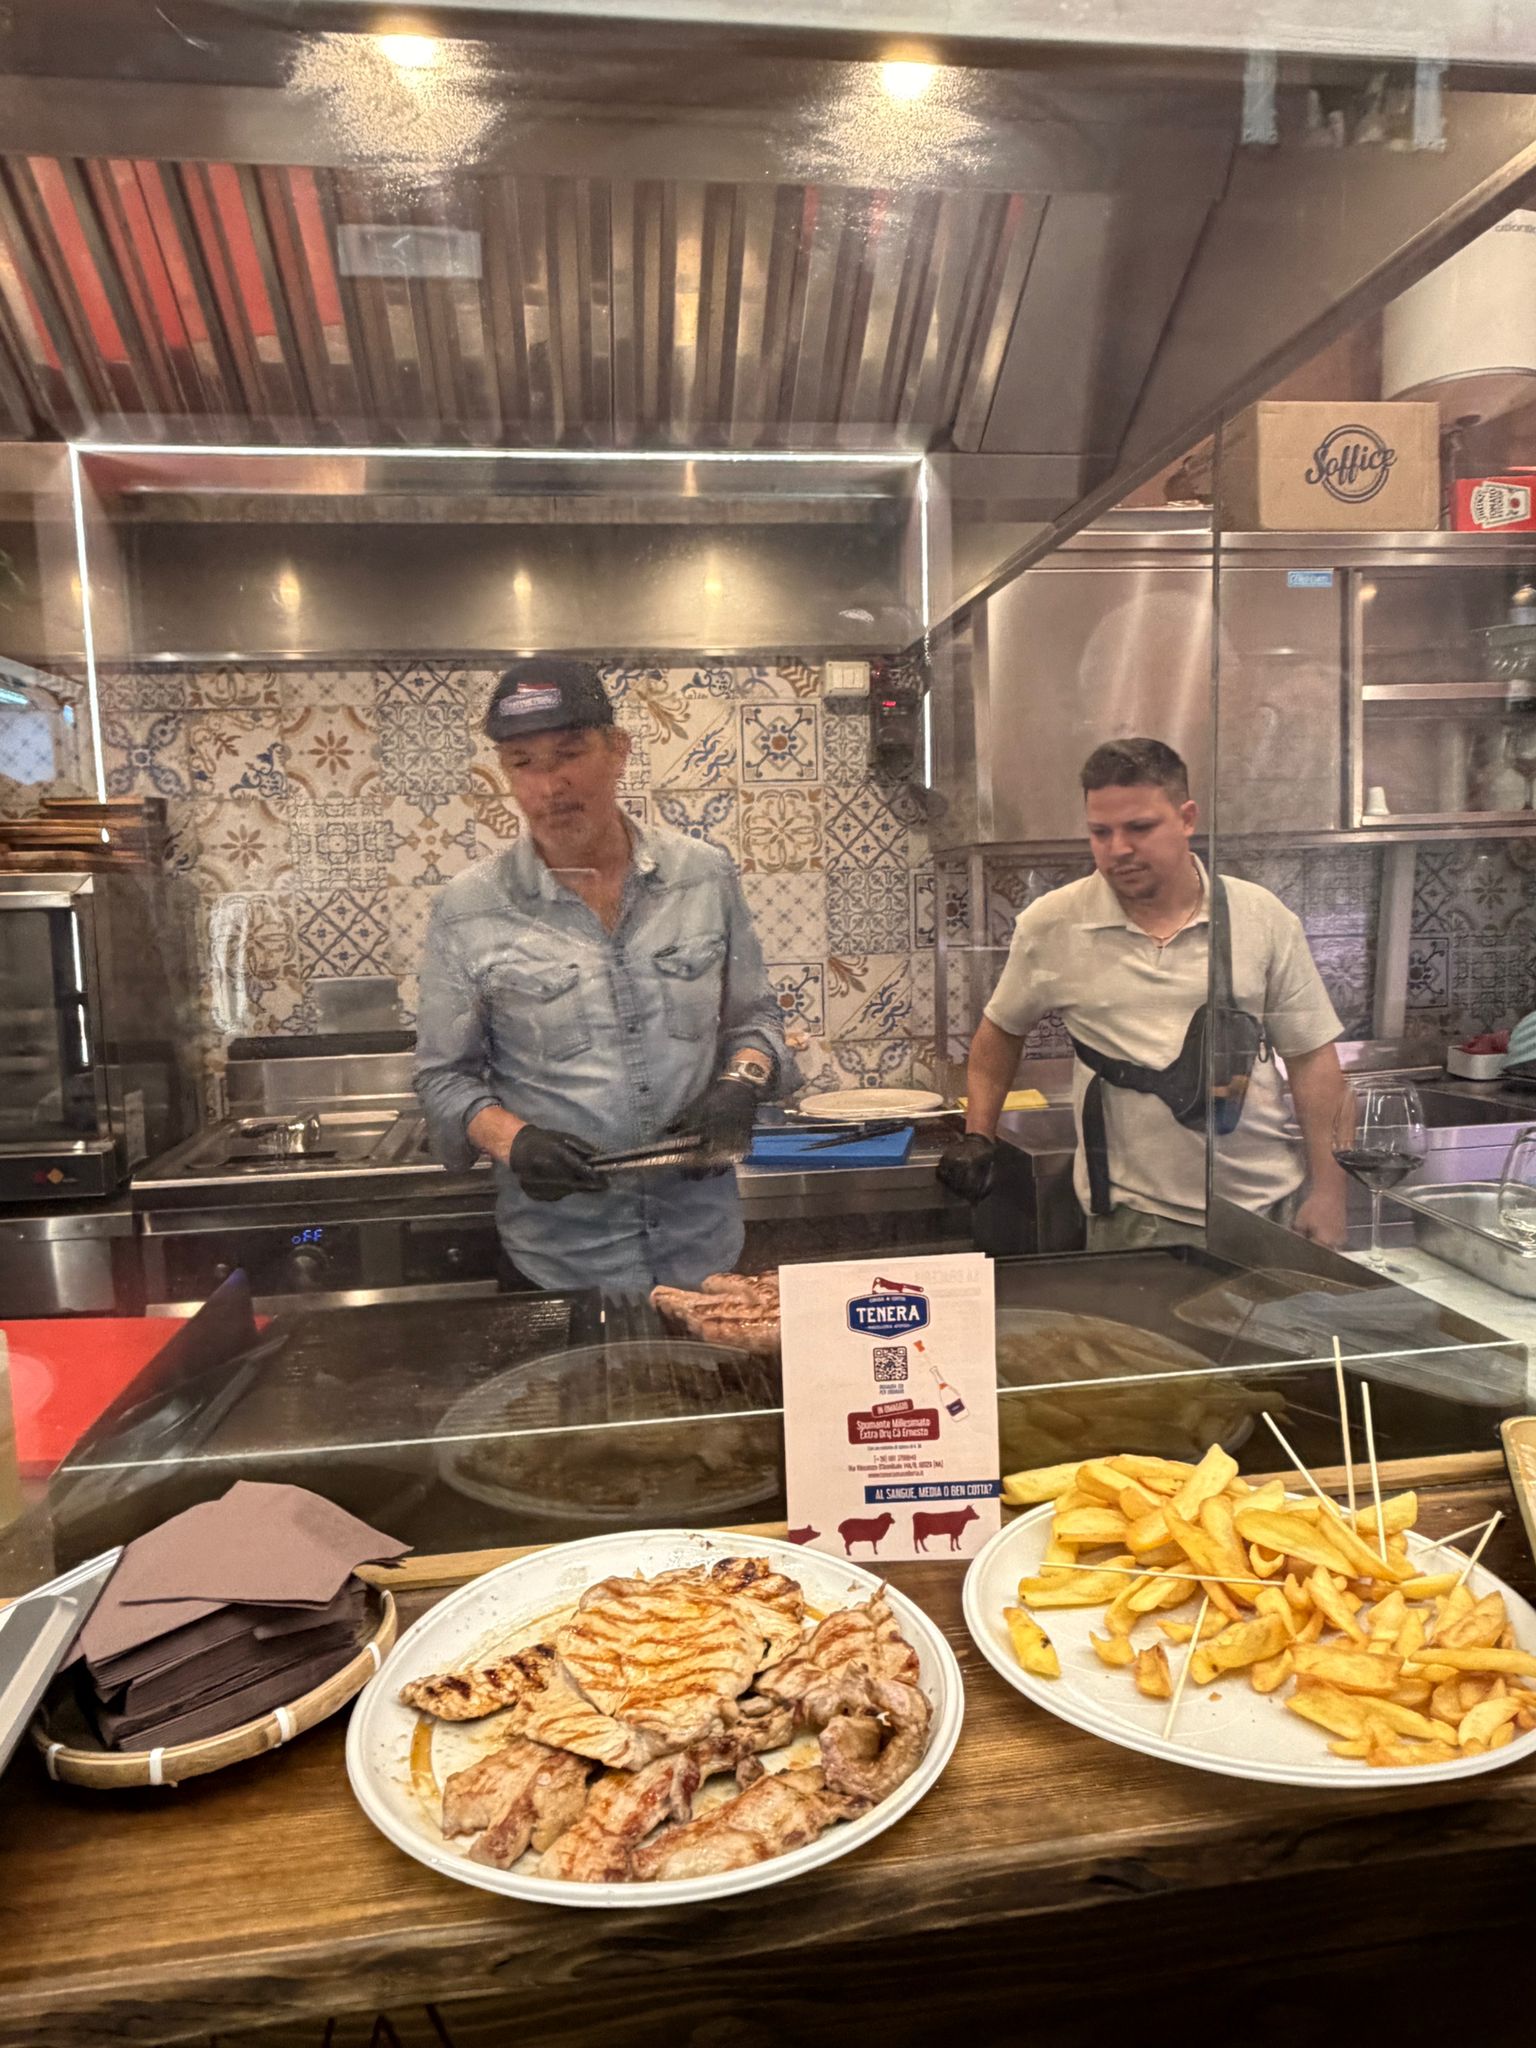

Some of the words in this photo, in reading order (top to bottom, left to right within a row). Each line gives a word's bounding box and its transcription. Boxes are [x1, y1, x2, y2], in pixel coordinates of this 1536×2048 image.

[1305, 443, 1397, 486] Soffice
[855, 1305, 920, 1323] TENERA
[856, 1420, 891, 1431] Spumante
[892, 1418, 931, 1428] Millesimato
[860, 1429, 878, 1440] Extra
[879, 1428, 892, 1439] Dry
[902, 1427, 929, 1438] Ernesto
[875, 1489, 885, 1500] AL
[918, 1485, 942, 1498] MEDIA
[943, 1485, 949, 1496] O
